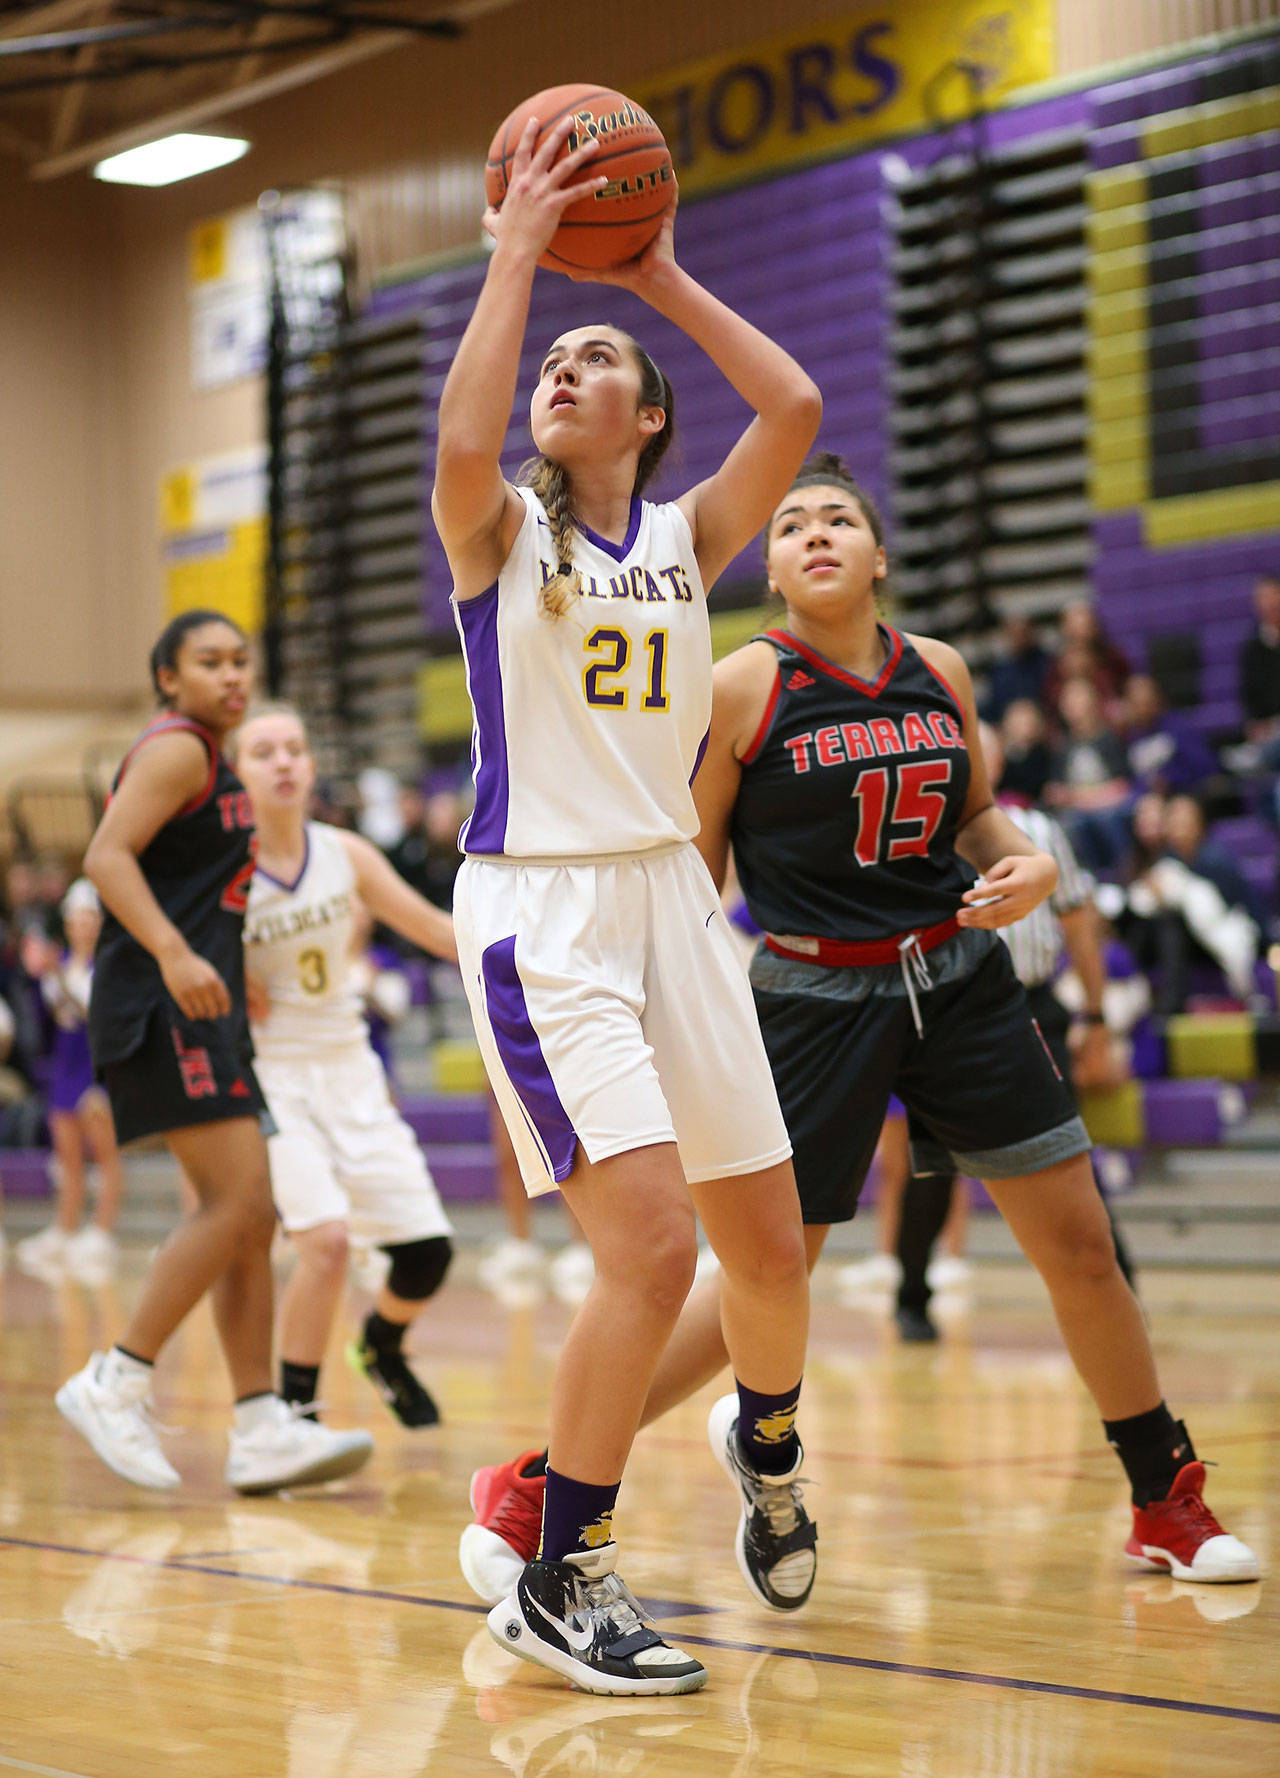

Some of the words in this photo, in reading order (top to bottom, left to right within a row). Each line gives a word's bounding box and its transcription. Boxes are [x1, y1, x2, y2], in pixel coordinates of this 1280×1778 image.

[645, 18, 904, 169] IORS
[594, 164, 671, 200] ELITE
[581, 625, 671, 713] 21
[851, 758, 951, 868] 15
[298, 947, 327, 995] 3
